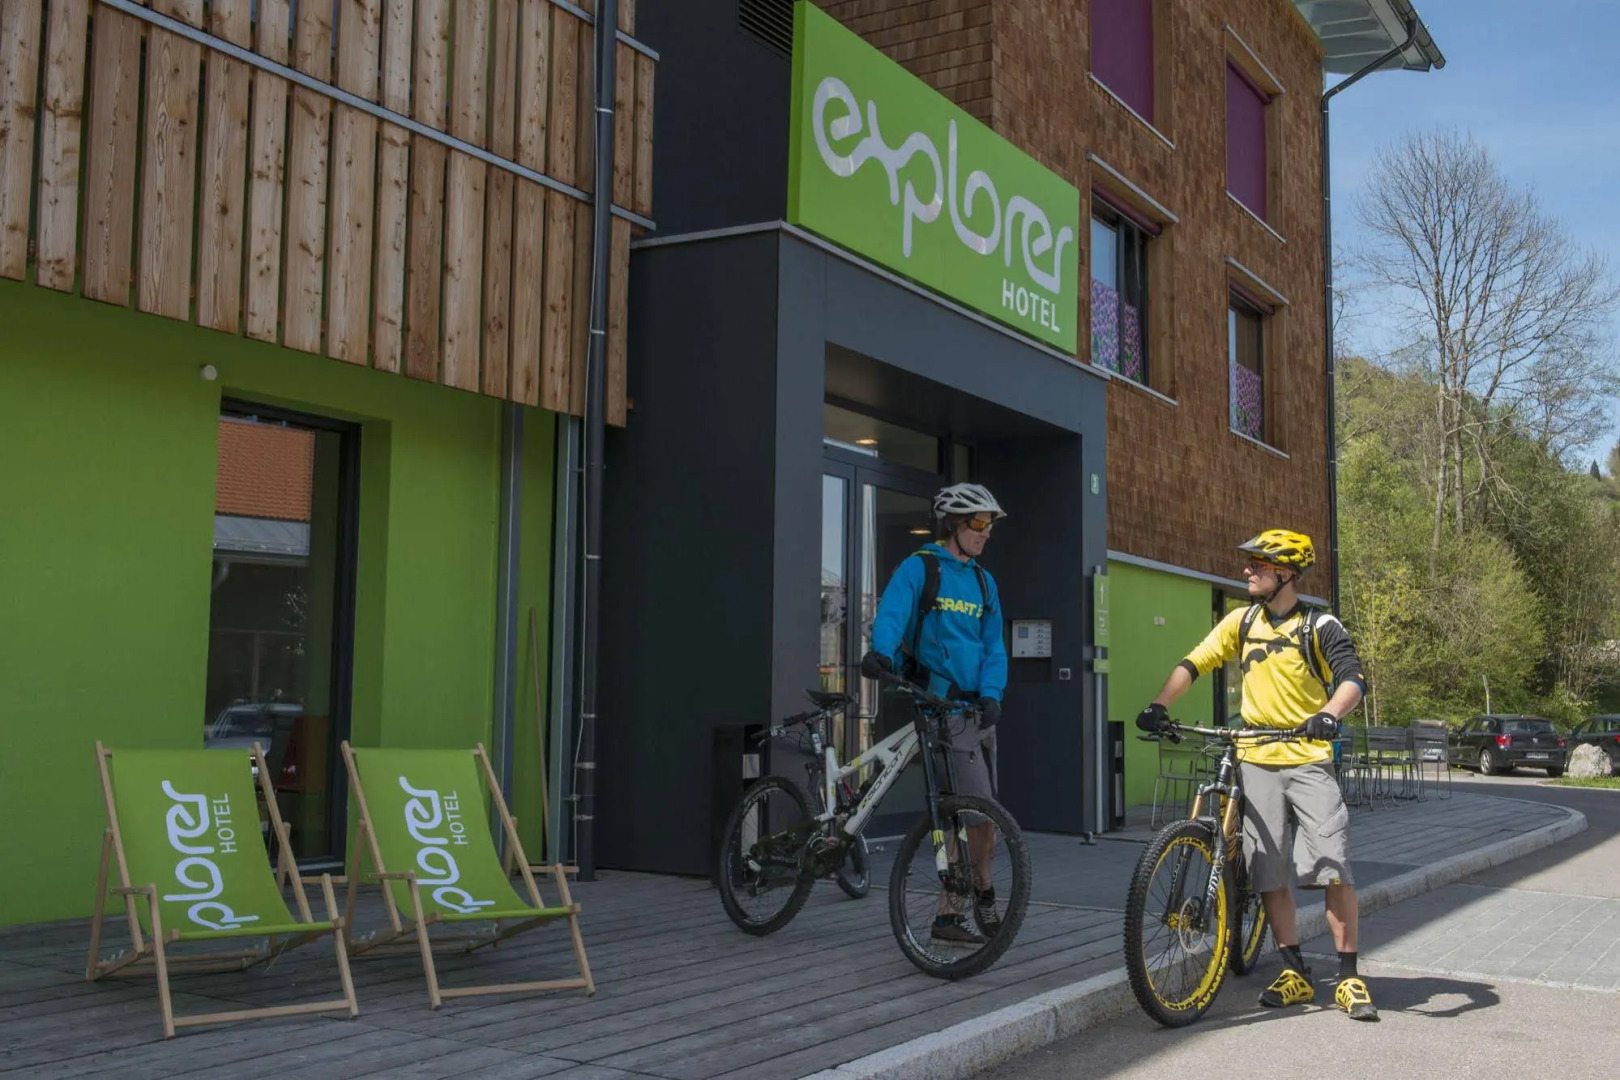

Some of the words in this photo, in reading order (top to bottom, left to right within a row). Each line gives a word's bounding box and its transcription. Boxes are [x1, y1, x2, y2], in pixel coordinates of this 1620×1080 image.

[812, 76, 1073, 294] explorer
[1002, 278, 1060, 333] HOTEL
[212, 793, 238, 854] HOTEL
[443, 790, 468, 845] HOTEL
